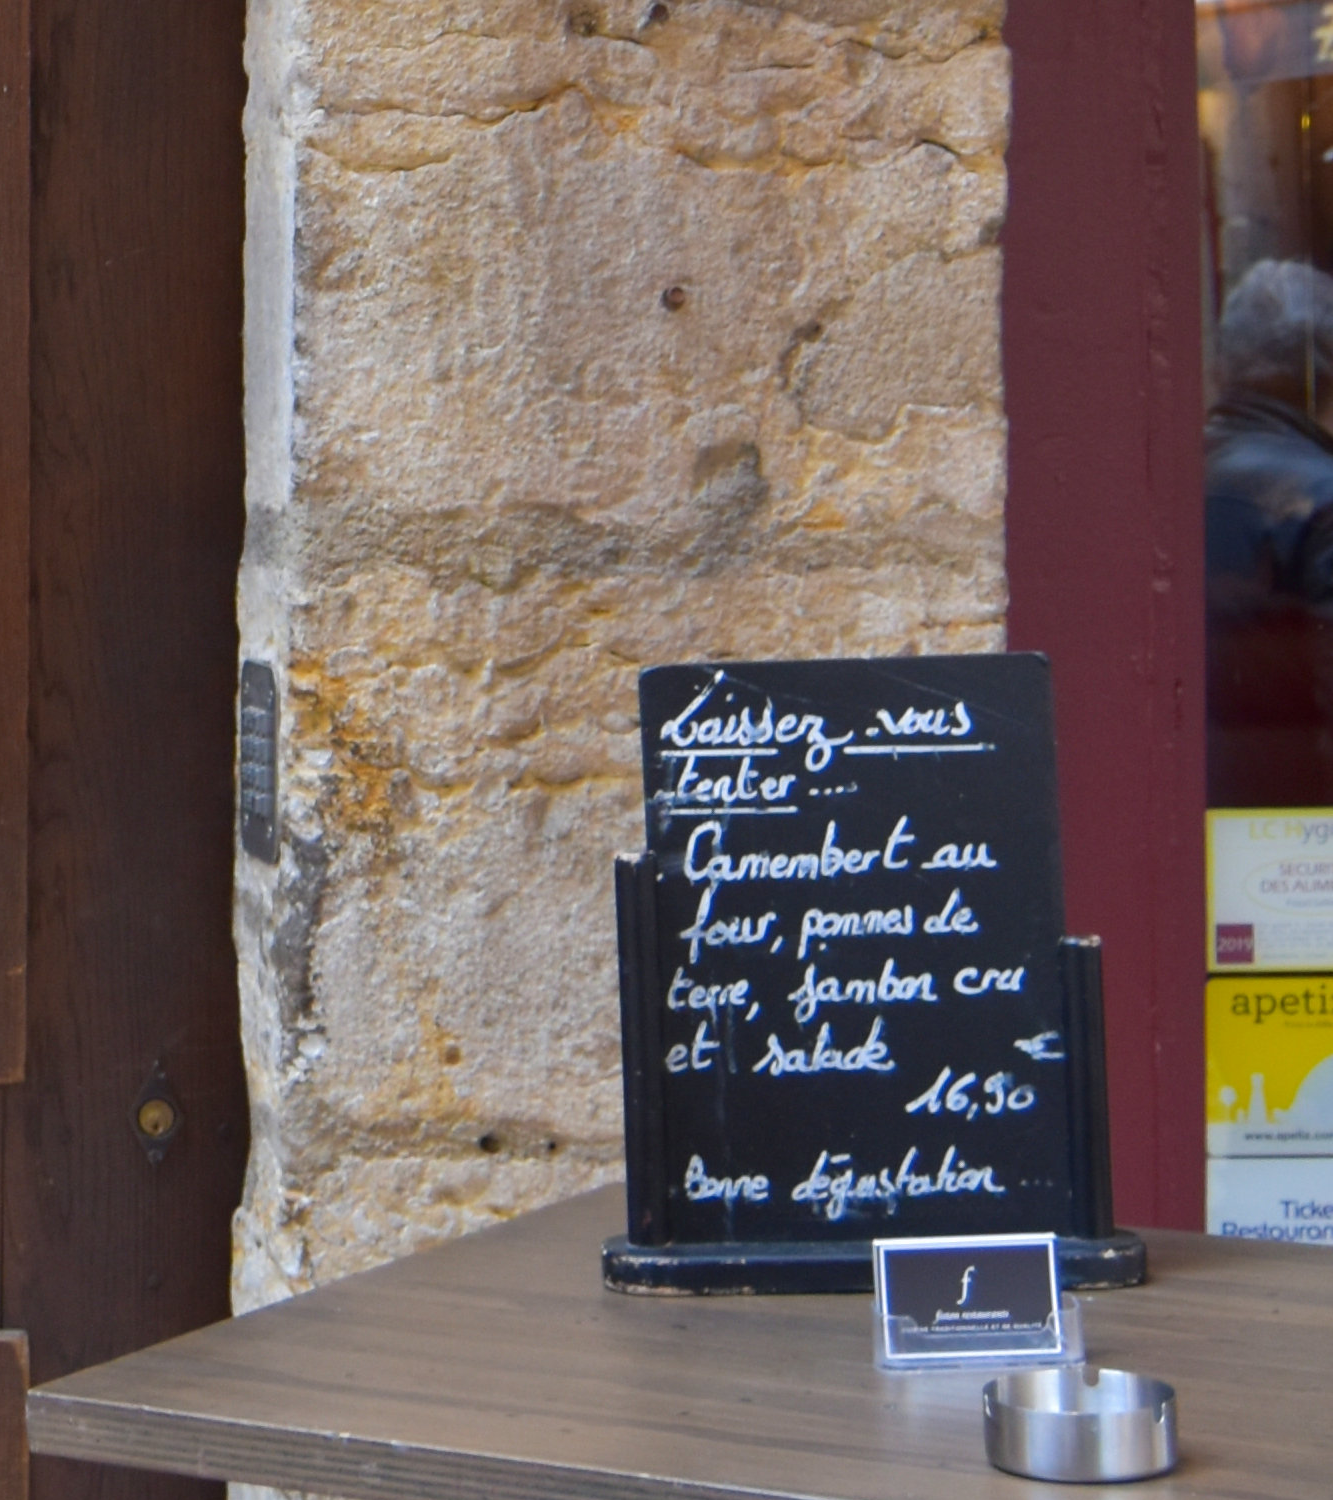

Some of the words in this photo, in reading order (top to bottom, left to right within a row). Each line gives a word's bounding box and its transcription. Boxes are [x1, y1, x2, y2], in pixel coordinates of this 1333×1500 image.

[684, 815, 915, 884] Camembert
[922, 841, 997, 869] au
[924, 888, 980, 934] de
[668, 966, 760, 1021] terre,
[953, 966, 1026, 995] cru
[665, 1021, 720, 1075] et
[753, 1016, 896, 1077] salade
[905, 1067, 1036, 1121] 16,90
[685, 1154, 771, 1202] Bonne
[956, 1265, 975, 1306] f
